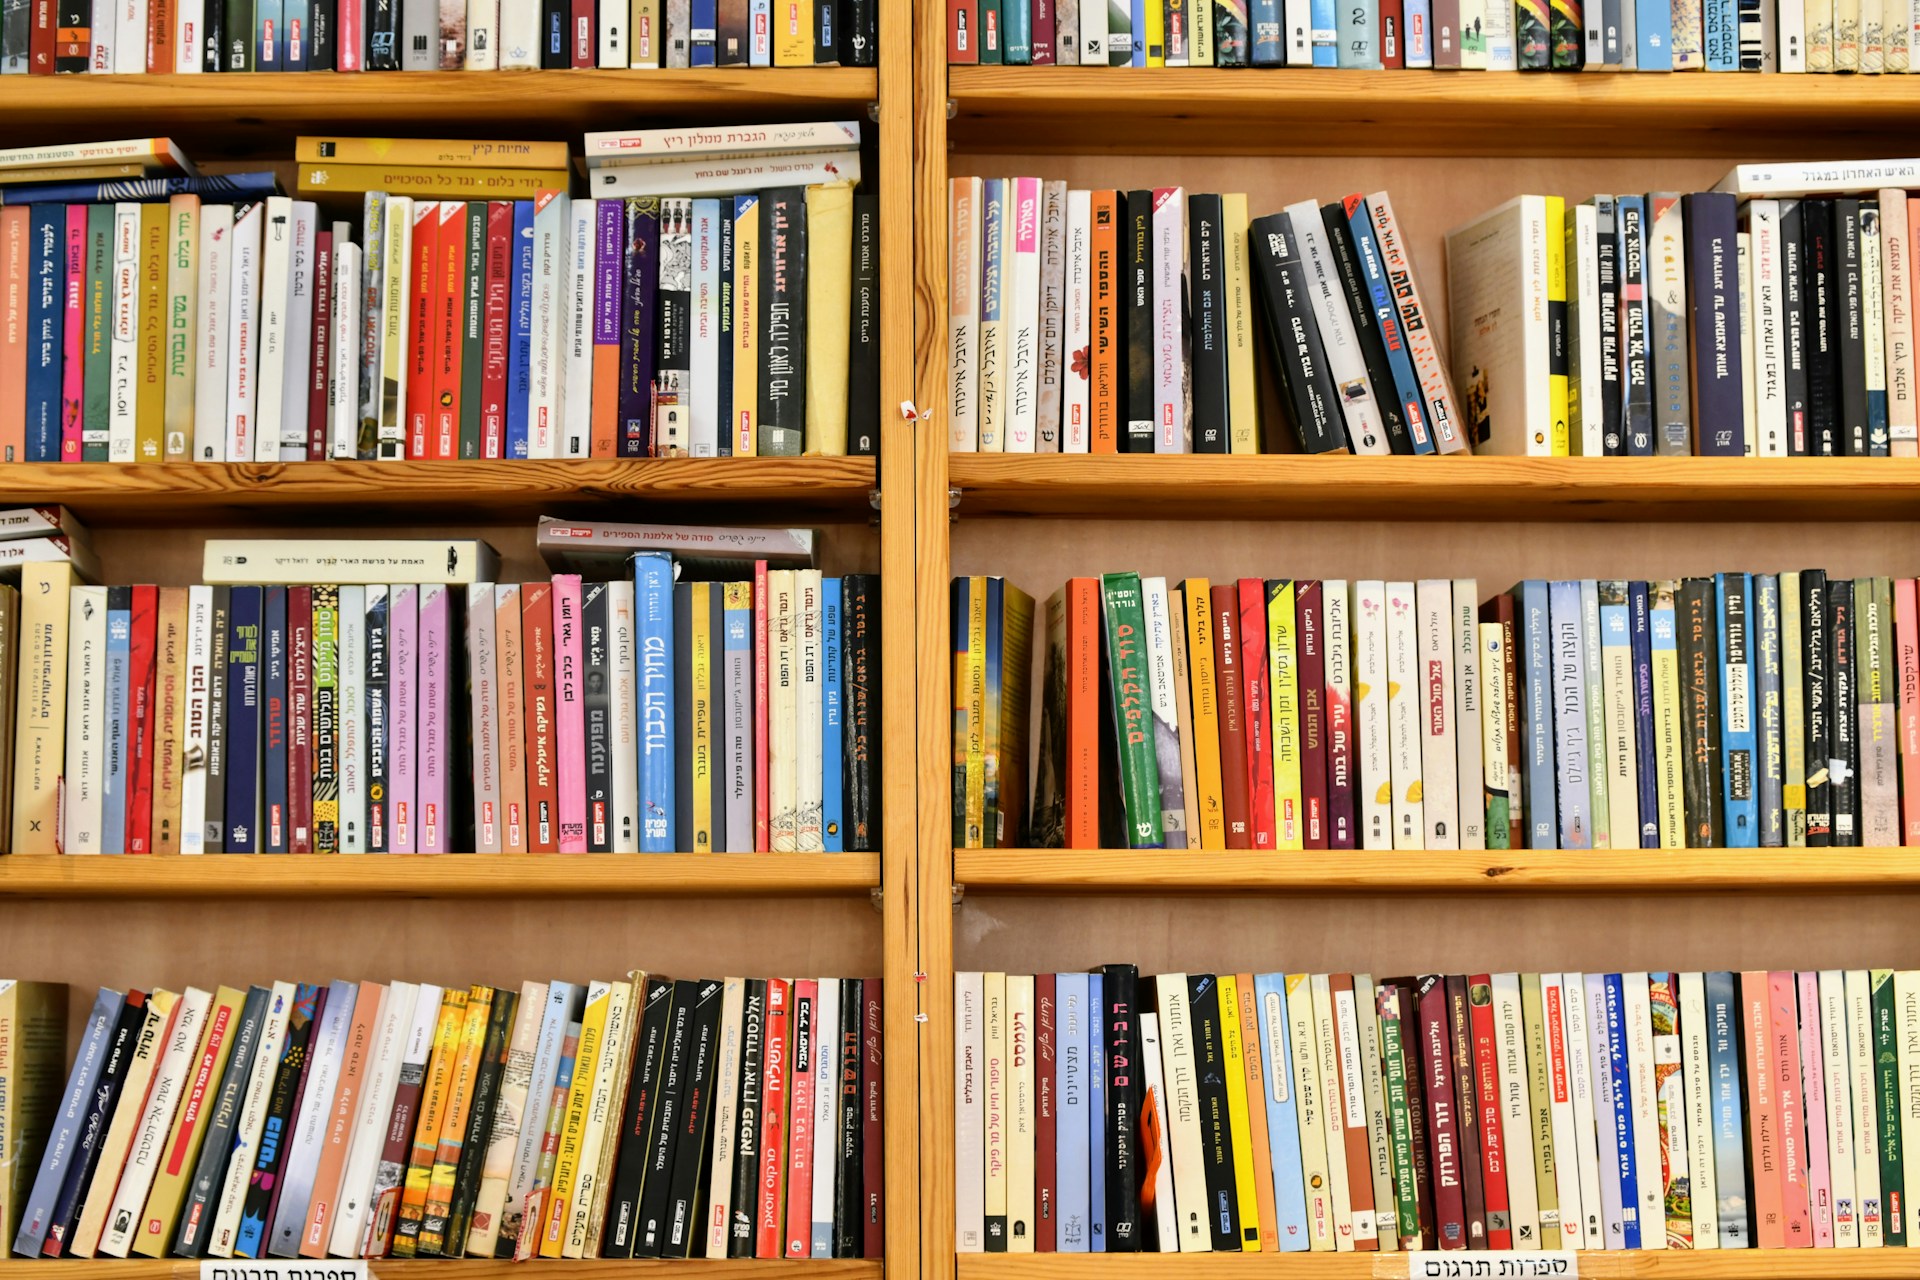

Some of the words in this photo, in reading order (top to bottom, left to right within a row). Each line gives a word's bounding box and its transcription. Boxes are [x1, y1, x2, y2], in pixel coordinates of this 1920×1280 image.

[473, 143, 491, 156] קיץ
[663, 135, 683, 148] ריץ
[688, 134, 721, 144] ממלון
[728, 131, 766, 142] הגברת
[1803, 171, 1838, 181] במגדל
[1843, 168, 1882, 180] האחרון
[700, 217, 709, 236] אנה
[860, 213, 870, 243] מרגרט
[1019, 199, 1033, 240] פאולה
[1623, 211, 1638, 234] פול
[41, 224, 54, 256] לעמוד
[175, 240, 189, 268] בלום
[700, 236, 709, 271] אנקוויסט
[40, 260, 53, 274] על
[521, 246, 531, 267] הבית
[860, 245, 870, 272] אטווד
[1628, 238, 1640, 277] אוסטר
[521, 273, 532, 297] בקצה
[1098, 251, 1109, 299] ההספד
[1136, 268, 1145, 285] ספר
[1391, 271, 1412, 297] שם
[42, 277, 52, 308] זנזיבר
[69, 282, 79, 308] נוגה
[699, 282, 709, 310] השיבה
[1136, 287, 1145, 307] האש
[1714, 295, 1724, 310] עד
[173, 295, 187, 328] נשים
[519, 301, 530, 328] הלילה
[663, 300, 672, 340] אומברטו
[699, 312, 709, 338] הביתה
[1401, 303, 1424, 331] שם
[1631, 307, 1641, 337] מהיד
[860, 320, 870, 342] גרייס
[1099, 307, 1109, 354] השישי
[1715, 312, 1726, 351] שאמצא
[172, 334, 185, 376] נבונות
[663, 342, 671, 359] אקו
[954, 326, 967, 367] איזבל
[1629, 340, 1643, 356] אל
[1632, 359, 1645, 385] הפה
[1717, 353, 1728, 378] אותך
[954, 370, 966, 416] איינדה
[603, 530, 640, 539] הספירים
[643, 532, 673, 541] אלמנת
[675, 532, 688, 541] של
[692, 534, 714, 542] סודה
[561, 597, 573, 618] רומן
[972, 597, 982, 622] דיאנה
[1330, 599, 1342, 639] אליזבת
[1729, 595, 1743, 615] נדין
[319, 611, 333, 636] סוזן
[562, 623, 571, 647] גארי
[42, 624, 53, 656] מועדון
[972, 626, 982, 654] גבלדון
[1118, 624, 1134, 659] סוד
[1561, 622, 1578, 658] הקצה
[319, 641, 331, 683] מיינוט
[561, 656, 572, 679] כלב
[644, 637, 665, 687] מחיר
[1330, 644, 1343, 684] גילברט
[1562, 663, 1577, 681] של
[1904, 645, 1916, 703] שייקספיר
[41, 660, 52, 718] הפיקוויקים
[191, 665, 204, 691] הבן
[562, 682, 574, 701] לבן
[972, 665, 981, 695] נוסעת
[1838, 671, 1848, 708] עקדת
[371, 689, 382, 724] אשמת
[535, 696, 548, 732] נשיקה
[971, 700, 981, 727] מעבר
[1120, 667, 1144, 744] הקלפים
[1307, 689, 1319, 711] אבן
[1563, 687, 1579, 714] הכול
[190, 698, 202, 738] הטוב
[318, 690, 331, 744] שלושים
[644, 692, 665, 755] הכבוד
[697, 700, 706, 738] שפירית
[1334, 704, 1345, 726] עיר
[1839, 710, 1849, 742] יצחק
[589, 710, 605, 775] מפוענח
[970, 733, 981, 754] לזמן
[1307, 714, 1318, 749] הנחש
[1332, 730, 1345, 752] של
[320, 749, 331, 779] בנות
[371, 729, 382, 777] הכוכבים
[536, 736, 550, 787] איטלקית
[697, 745, 706, 778] בענבר
[1334, 755, 1347, 787] בנות
[745, 996, 761, 1056] אלכסנדר
[797, 1001, 810, 1027] כליל
[1752, 1001, 1763, 1029] אהבה
[349, 1023, 365, 1050] ליסה
[1013, 1012, 1026, 1067] רעמסס
[1754, 1031, 1765, 1069] ואוצרות
[346, 1052, 361, 1077] טדאו
[766, 1037, 783, 1091] השליח
[820, 1045, 829, 1079] המהגרים
[990, 1058, 1000, 1089] סיפורי
[1066, 1046, 1078, 1105] מצטיינים
[337, 1088, 352, 1115] שלוש
[796, 1081, 807, 1110] מלאך
[990, 1092, 1000, 1111] חייו
[1612, 1079, 1625, 1109] לילה
[1756, 1072, 1768, 1105] אחרים
[215, 1082, 238, 1128] ברוקלין
[1117, 1102, 1129, 1131] פטריק
[333, 1119, 345, 1143] נשים
[739, 1108, 755, 1155] פנפאן
[796, 1117, 806, 1140] בשר
[988, 1113, 999, 1129] של
[1372, 1110, 1385, 1142] אפריל
[1616, 1114, 1627, 1148] מסוים
[257, 1116, 282, 1169] פונטי
[990, 1131, 1000, 1146] מר
[766, 1148, 777, 1188] מרקוס
[794, 1148, 804, 1168] ודם
[991, 1148, 1002, 1177] פיקרי
[1376, 1147, 1388, 1176] בפריז
[1620, 1154, 1630, 1178] אחד
[577, 1174, 592, 1206] ספרית
[764, 1191, 776, 1228] זוסאק
[570, 1211, 587, 1246] פועלים
[213, 1268, 279, 1280] תרגום
[287, 1268, 356, 1280] ספרות
[1425, 1259, 1490, 1277] תרגום
[1498, 1259, 1568, 1276] ספרות
